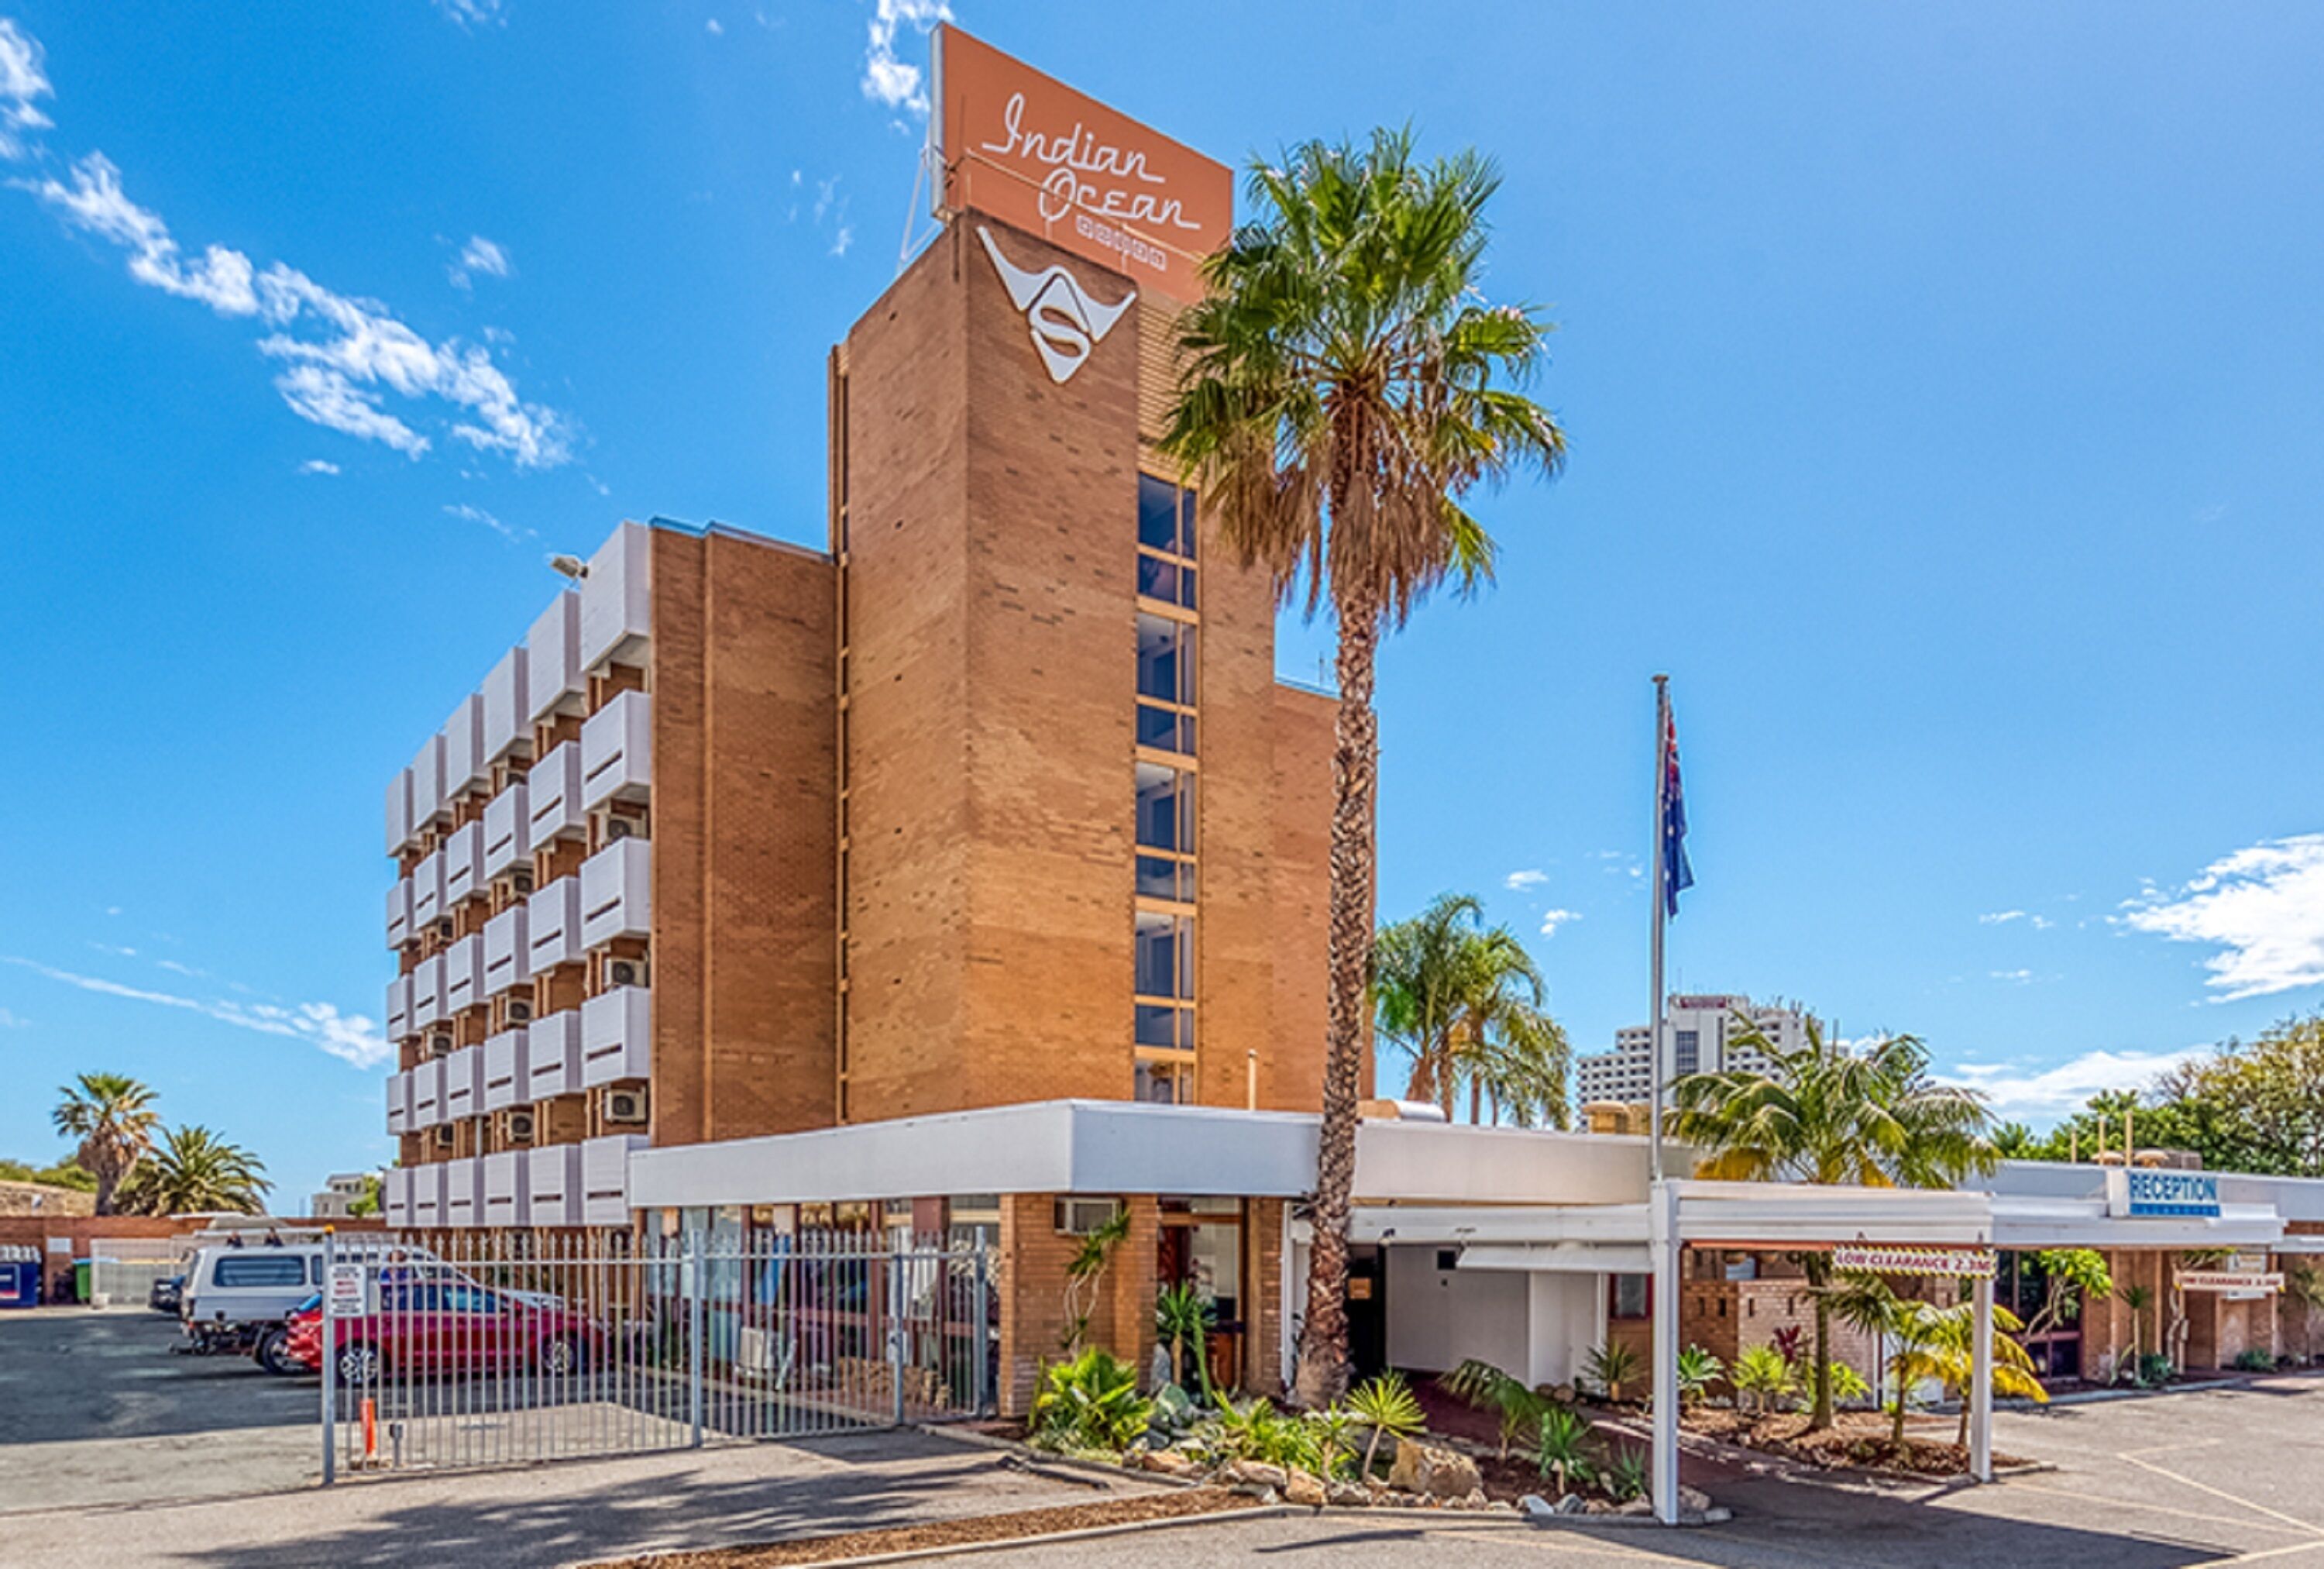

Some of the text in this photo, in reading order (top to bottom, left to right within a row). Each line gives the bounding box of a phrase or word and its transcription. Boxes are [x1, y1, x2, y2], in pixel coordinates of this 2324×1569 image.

[982, 92, 1165, 183] Indian
[1038, 167, 1201, 230] Ocean
[2130, 1173, 2216, 1200] RECEPTION
[1836, 1254, 1865, 1265] LOW
[1869, 1254, 1948, 1270] CLEARANCE
